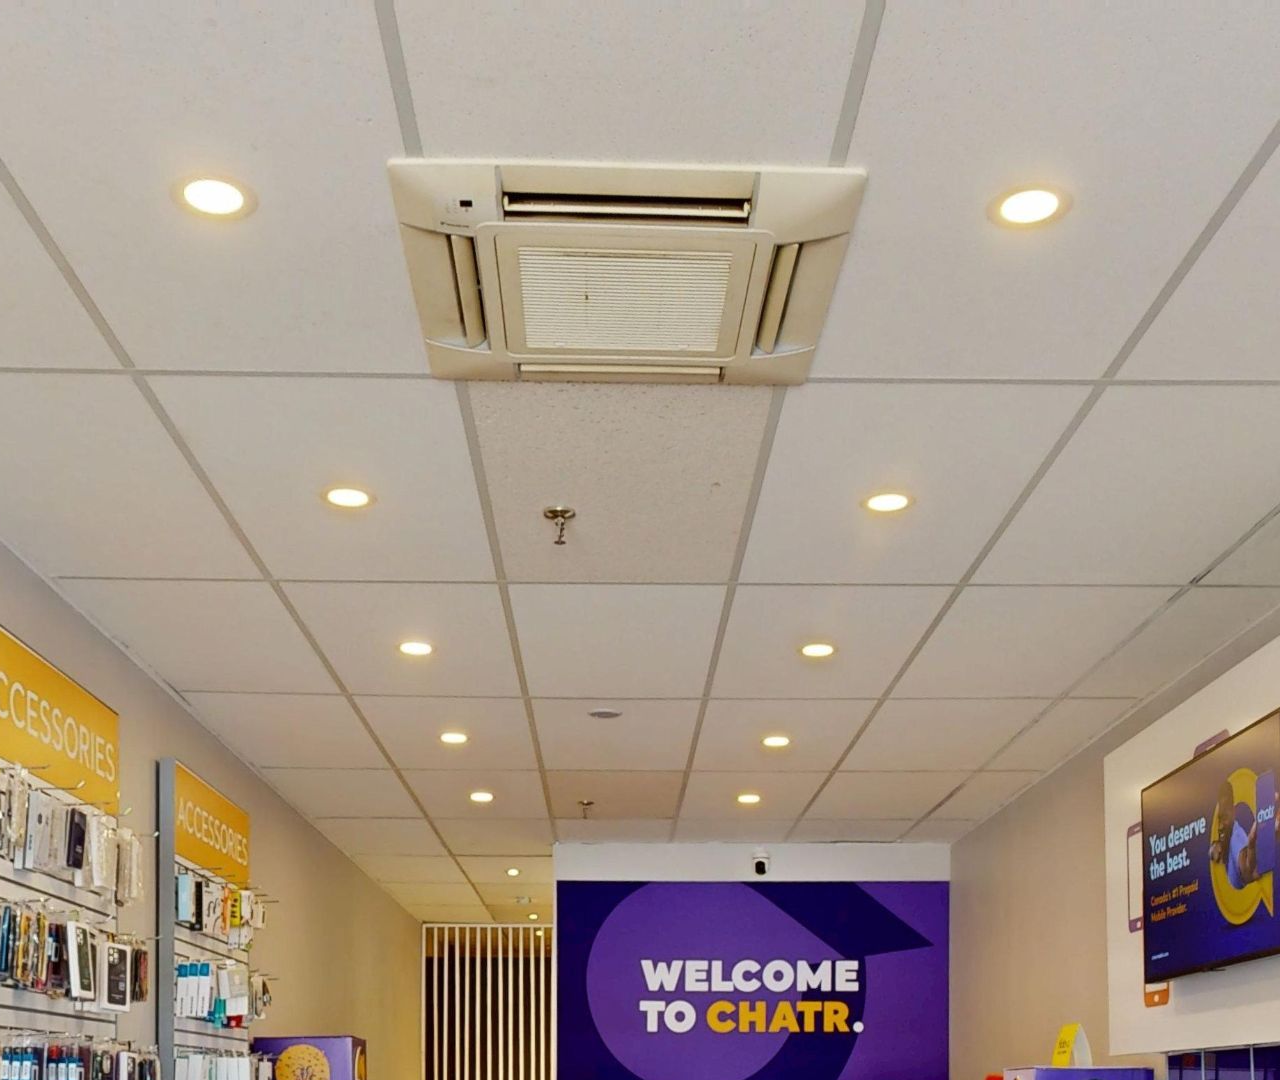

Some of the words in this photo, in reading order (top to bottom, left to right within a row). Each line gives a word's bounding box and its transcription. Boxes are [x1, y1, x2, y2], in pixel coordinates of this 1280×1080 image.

[177, 801, 248, 867] ACCESSORIES
[1149, 834, 1166, 857] You
[1167, 816, 1206, 846] deserve
[1150, 857, 1165, 880] the
[1166, 848, 1190, 874] best.
[641, 960, 859, 992] WELCOME
[639, 1000, 696, 1033] TO
[707, 1001, 864, 1033] CHATR.
